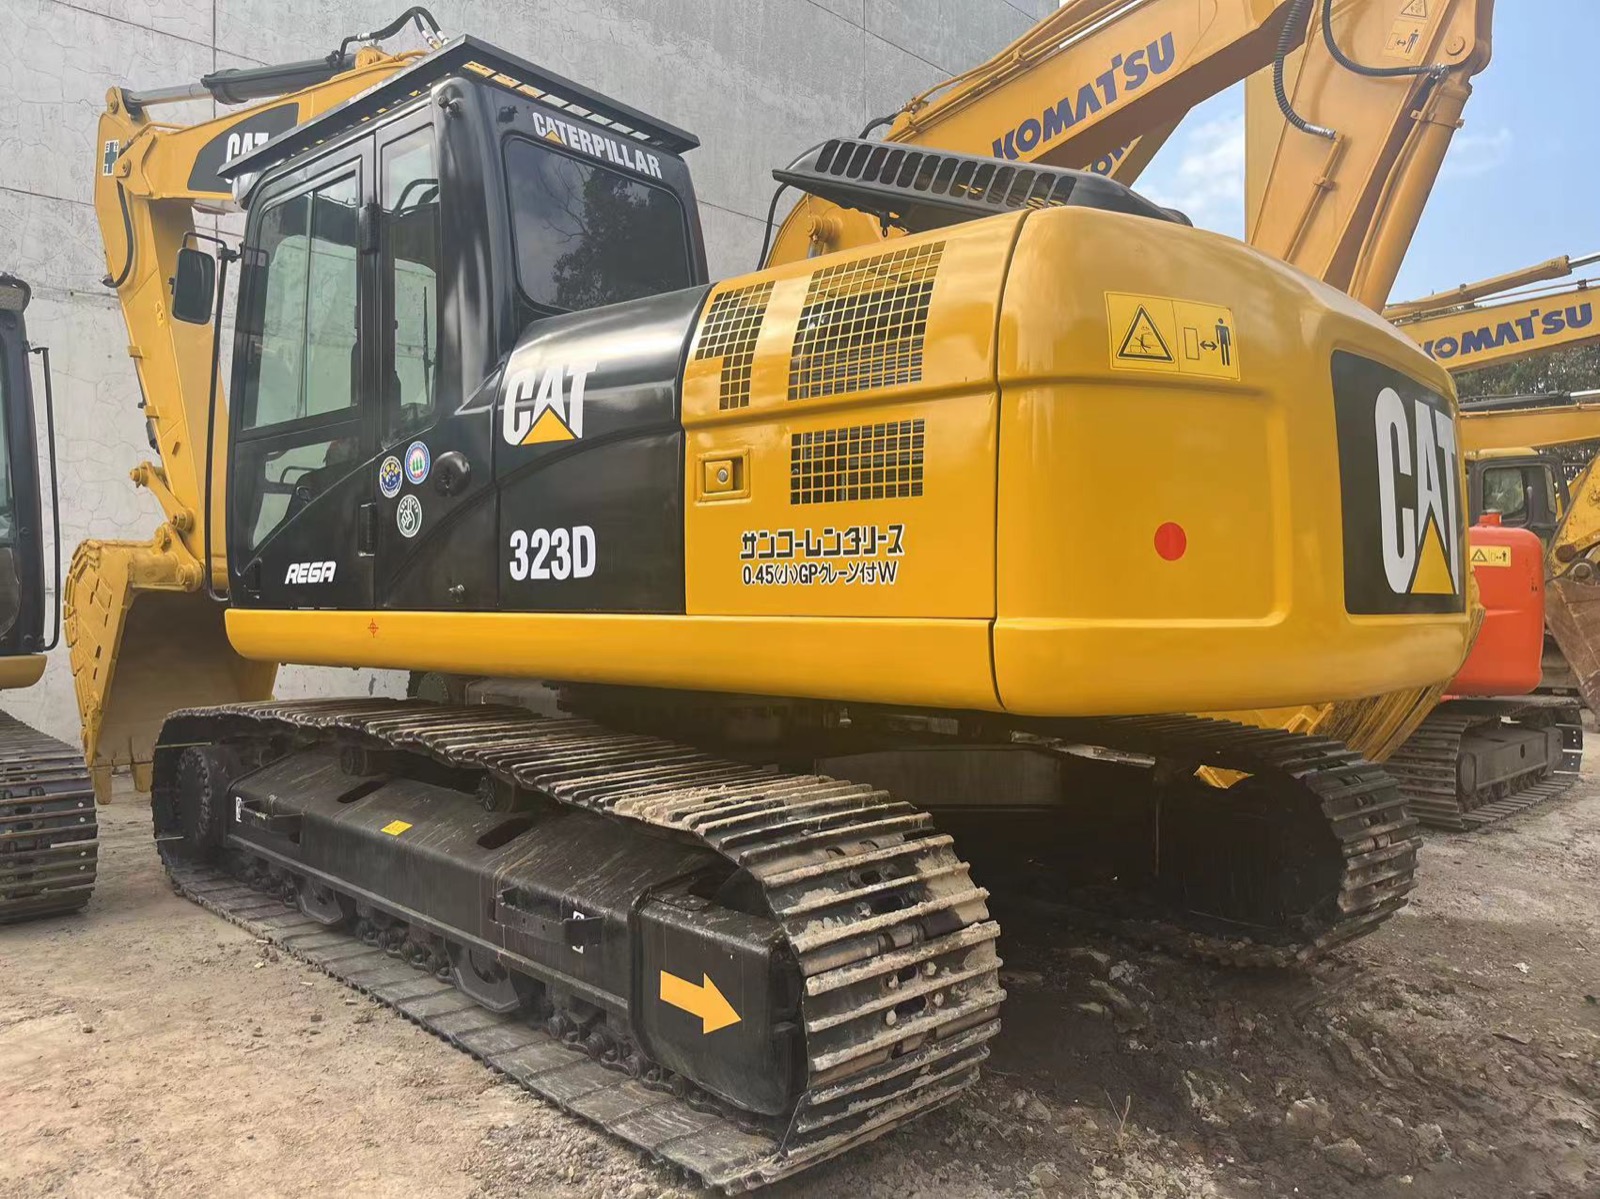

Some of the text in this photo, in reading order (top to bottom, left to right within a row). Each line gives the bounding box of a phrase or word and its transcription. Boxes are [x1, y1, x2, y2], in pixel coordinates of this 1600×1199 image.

[991, 31, 1176, 161] KOMATSU
[532, 112, 662, 180] CATERPILLAR
[502, 360, 598, 446] CAT
[1375, 386, 1460, 595] CAT
[284, 560, 337, 585] REGA
[509, 525, 596, 581] 323D
[740, 523, 905, 561] サンコーレンタリース
